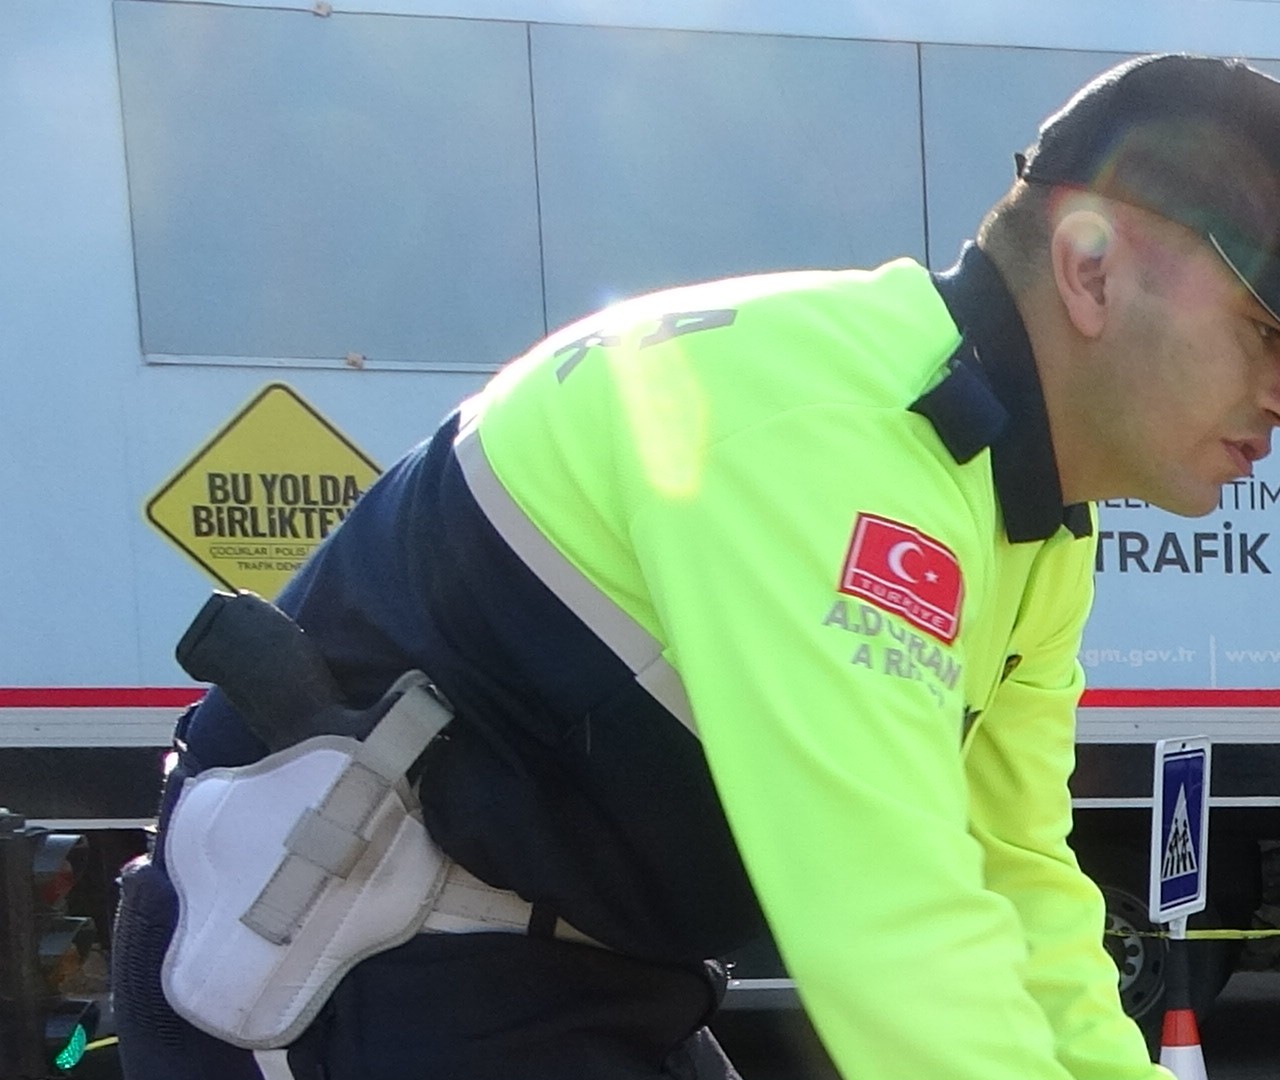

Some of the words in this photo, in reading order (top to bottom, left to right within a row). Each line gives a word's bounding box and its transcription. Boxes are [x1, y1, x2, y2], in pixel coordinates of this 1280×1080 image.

[208, 472, 252, 504] BU
[259, 473, 359, 506] YOLDA
[1096, 521, 1271, 574] TRAFİK
